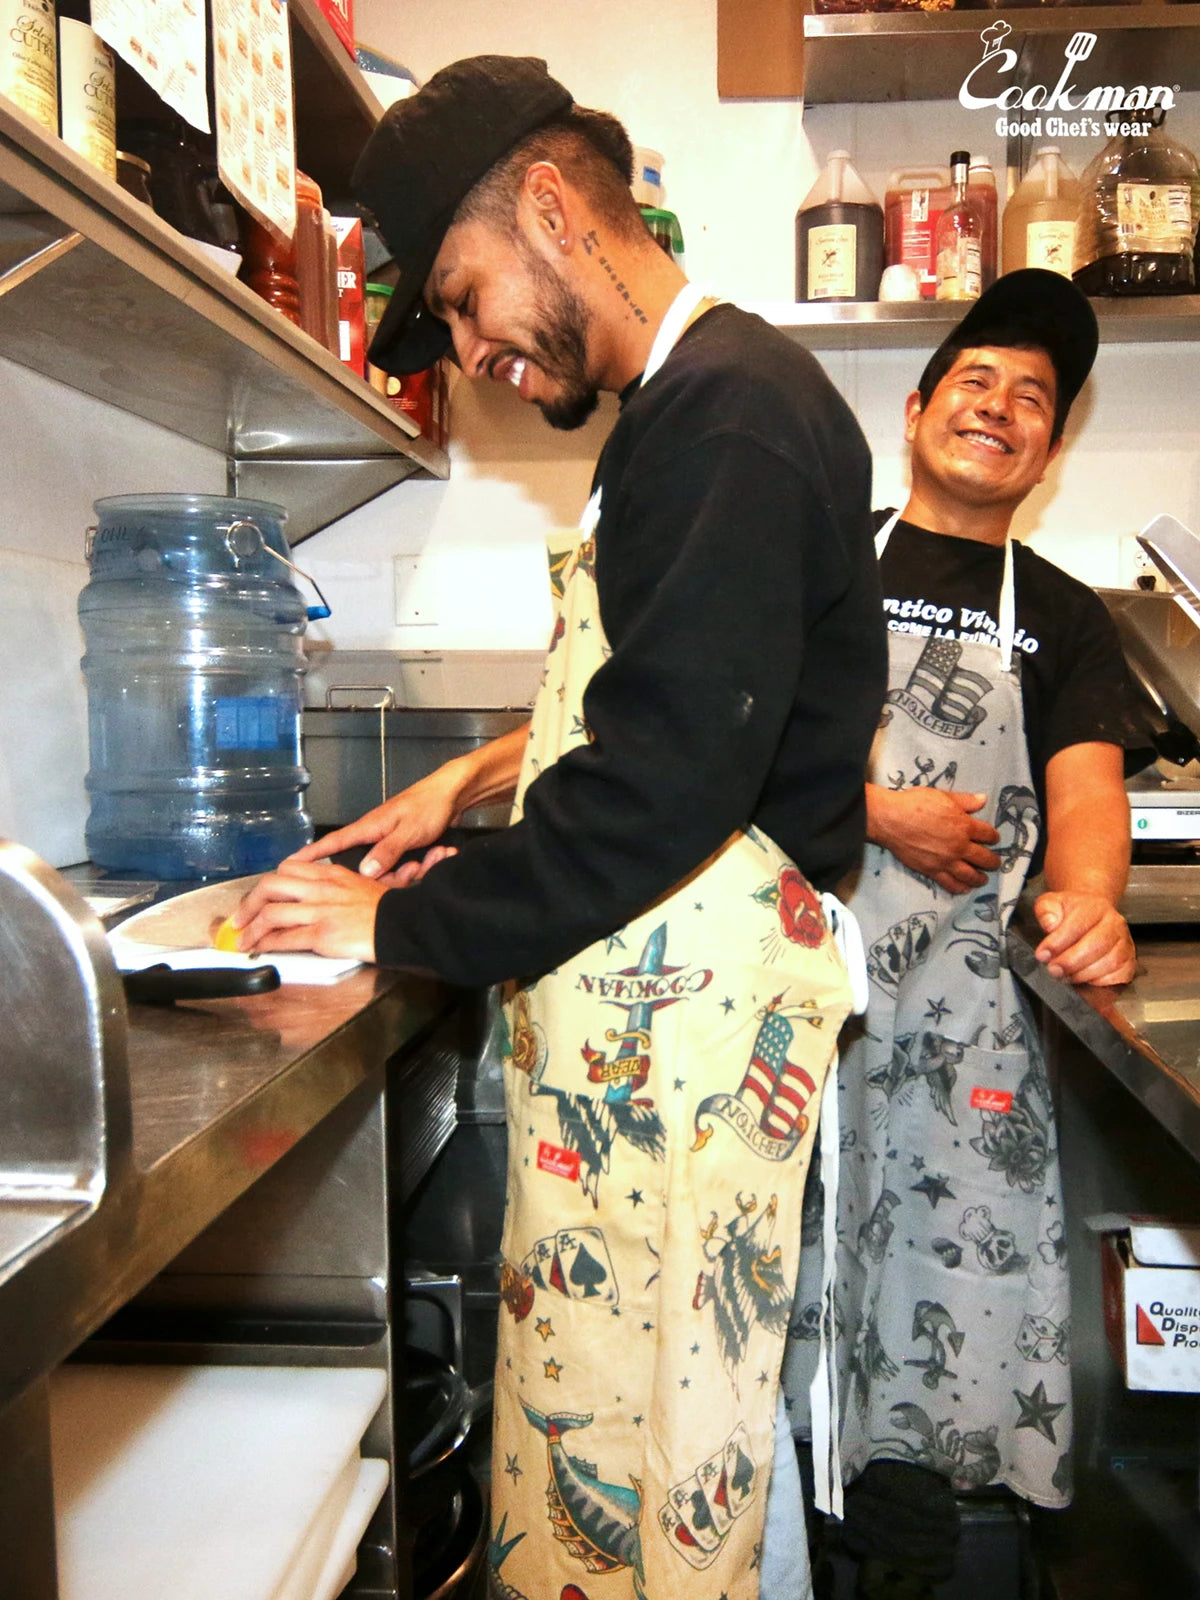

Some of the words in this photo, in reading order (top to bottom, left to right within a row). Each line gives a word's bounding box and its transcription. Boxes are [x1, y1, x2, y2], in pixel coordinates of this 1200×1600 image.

[887, 619, 933, 638] COME
[960, 607, 1039, 654] Vinio
[575, 968, 714, 999] COOKMAN
